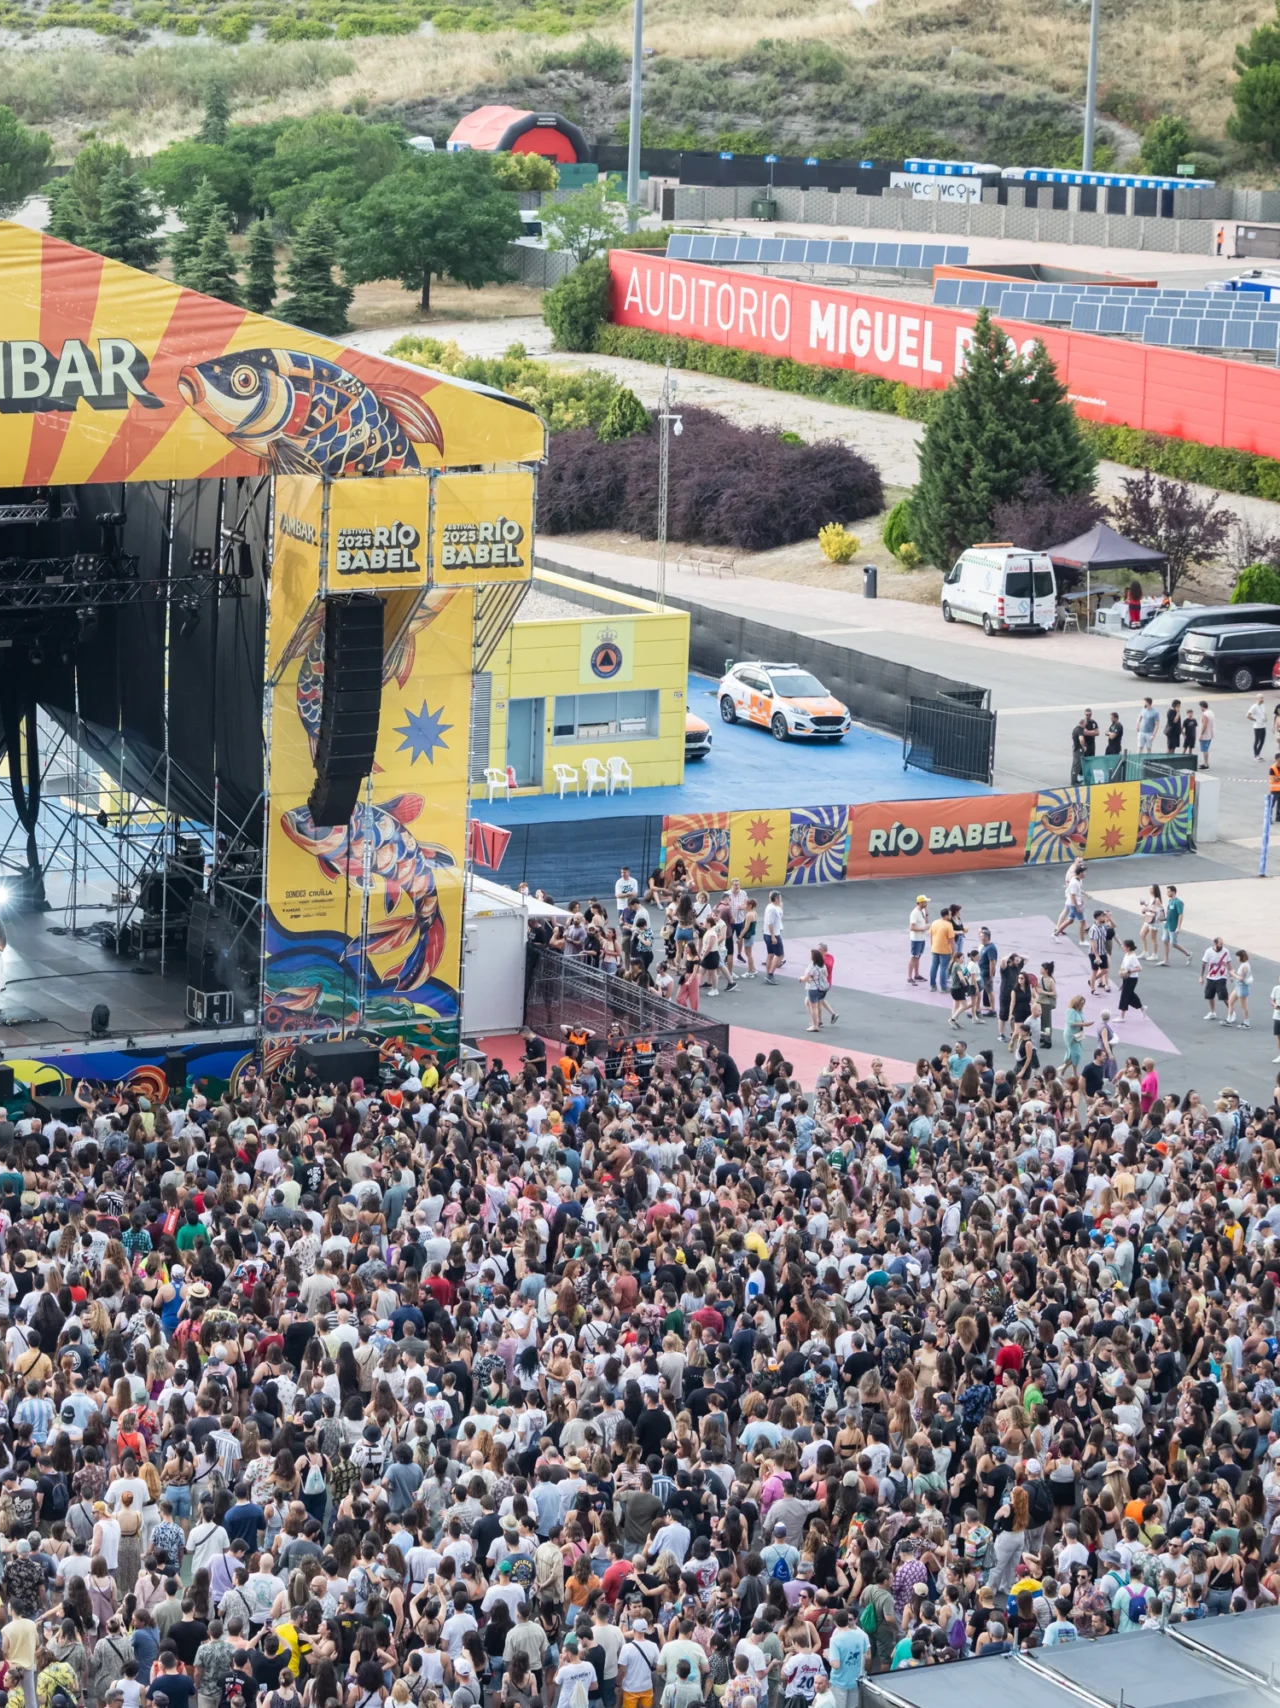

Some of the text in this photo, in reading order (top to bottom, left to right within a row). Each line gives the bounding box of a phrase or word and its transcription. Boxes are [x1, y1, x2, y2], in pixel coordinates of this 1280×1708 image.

[623, 265, 791, 343] AUDITORIO
[809, 300, 943, 374] MIGUEL
[337, 519, 417, 548] 2025 RÍO
[442, 515, 521, 543] 2025 RÍO
[443, 523, 477, 531] FESTIVAL
[336, 547, 418, 572] BABEL
[441, 543, 521, 567] BABEL
[868, 820, 1015, 854] RÍO BABEL
